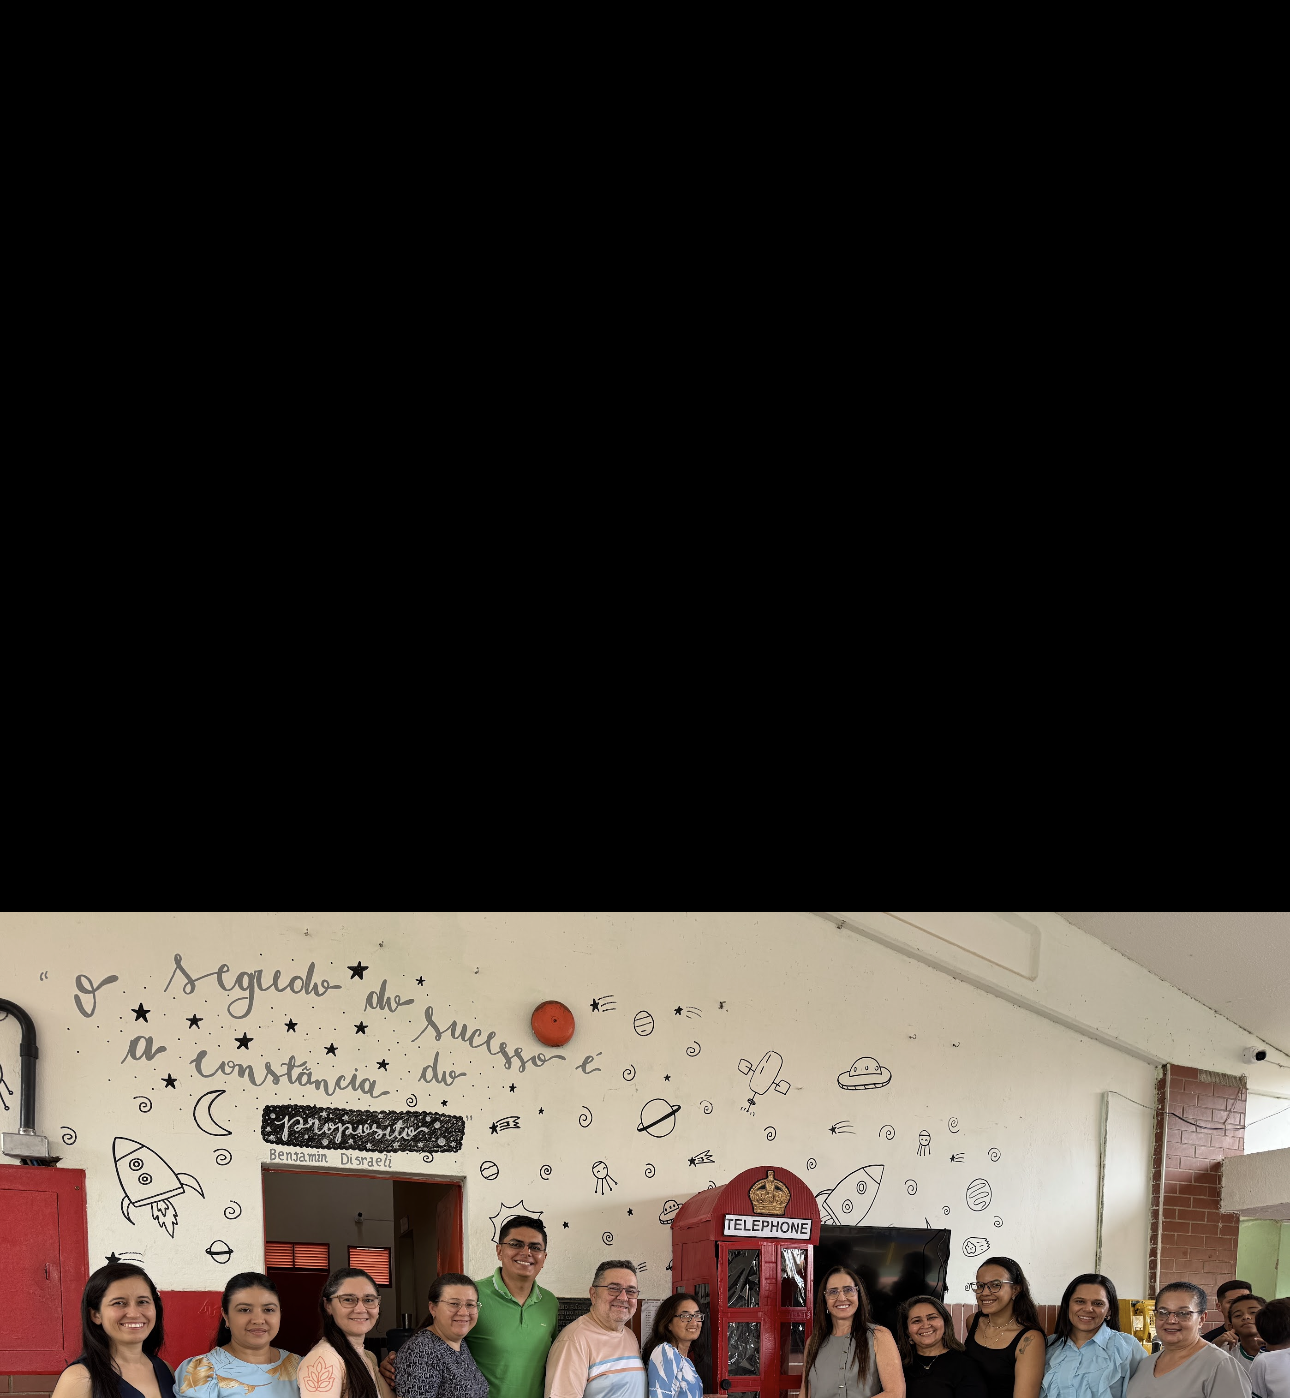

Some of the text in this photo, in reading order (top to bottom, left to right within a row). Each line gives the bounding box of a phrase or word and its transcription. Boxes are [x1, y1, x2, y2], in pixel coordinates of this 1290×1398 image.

[363, 979, 415, 1013] do
[121, 1035, 168, 1065] a
[417, 1051, 467, 1087] do
[340, 1152, 393, 1169] Disraeli
[725, 1218, 809, 1236] TELEPHONE
